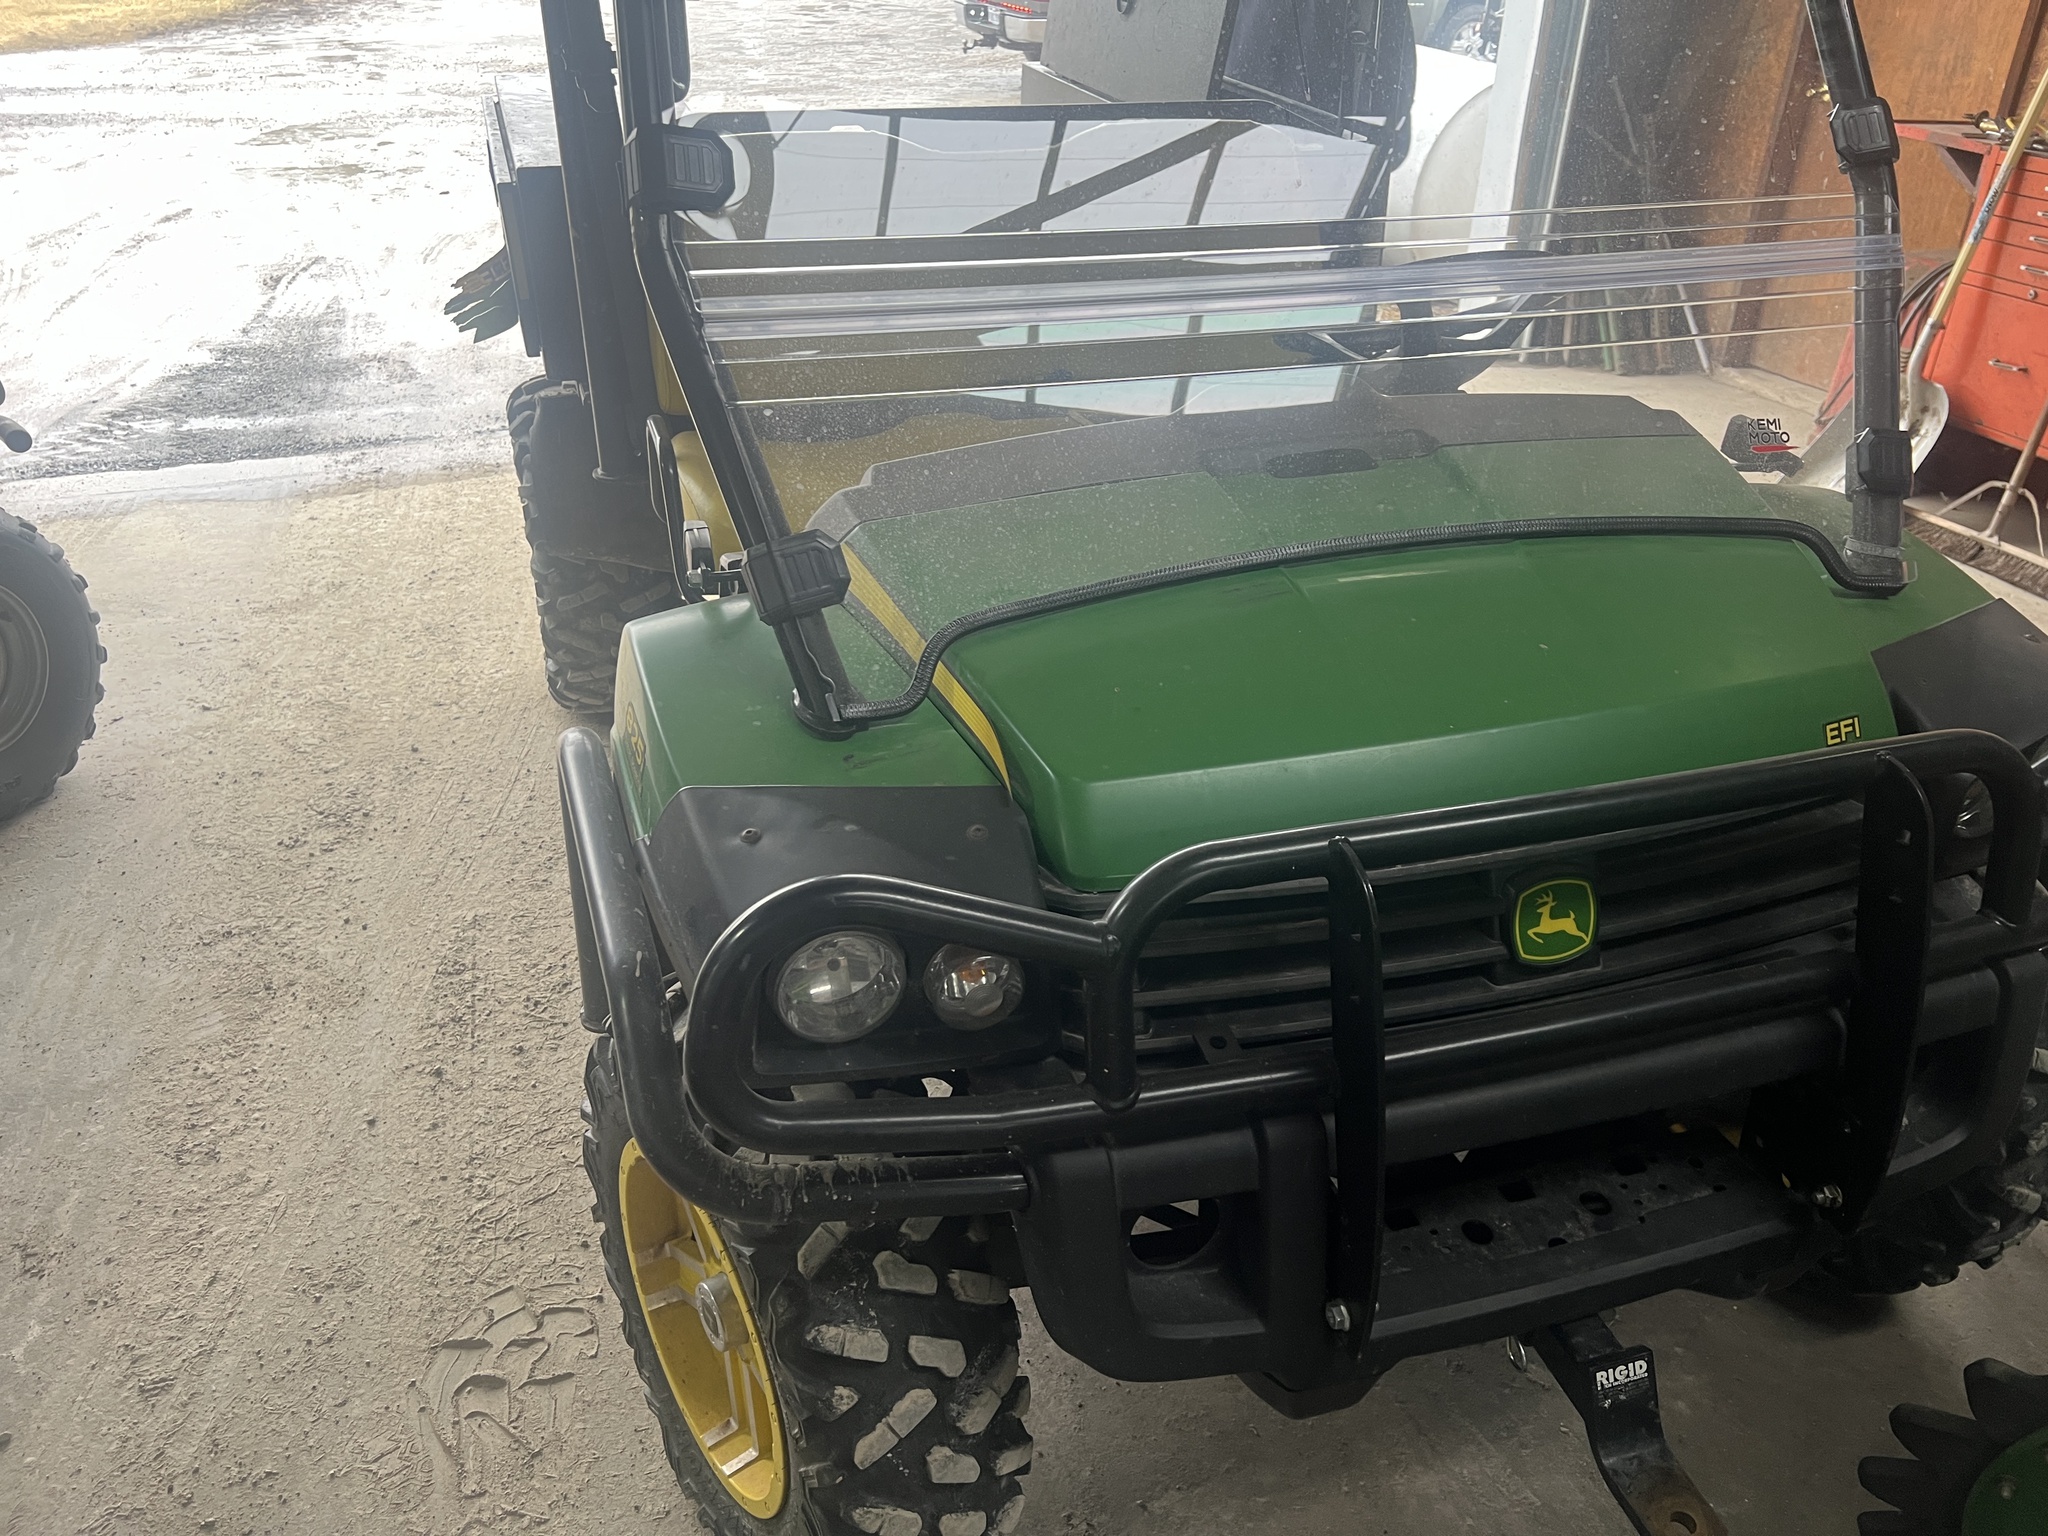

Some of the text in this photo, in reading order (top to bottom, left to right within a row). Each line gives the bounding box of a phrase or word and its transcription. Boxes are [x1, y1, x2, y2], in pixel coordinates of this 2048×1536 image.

[1748, 419, 1782, 431] KEMI
[1749, 432, 1791, 443] MOTO
[1825, 716, 1861, 746] EFI
[1596, 1360, 1648, 1386] RIGID
